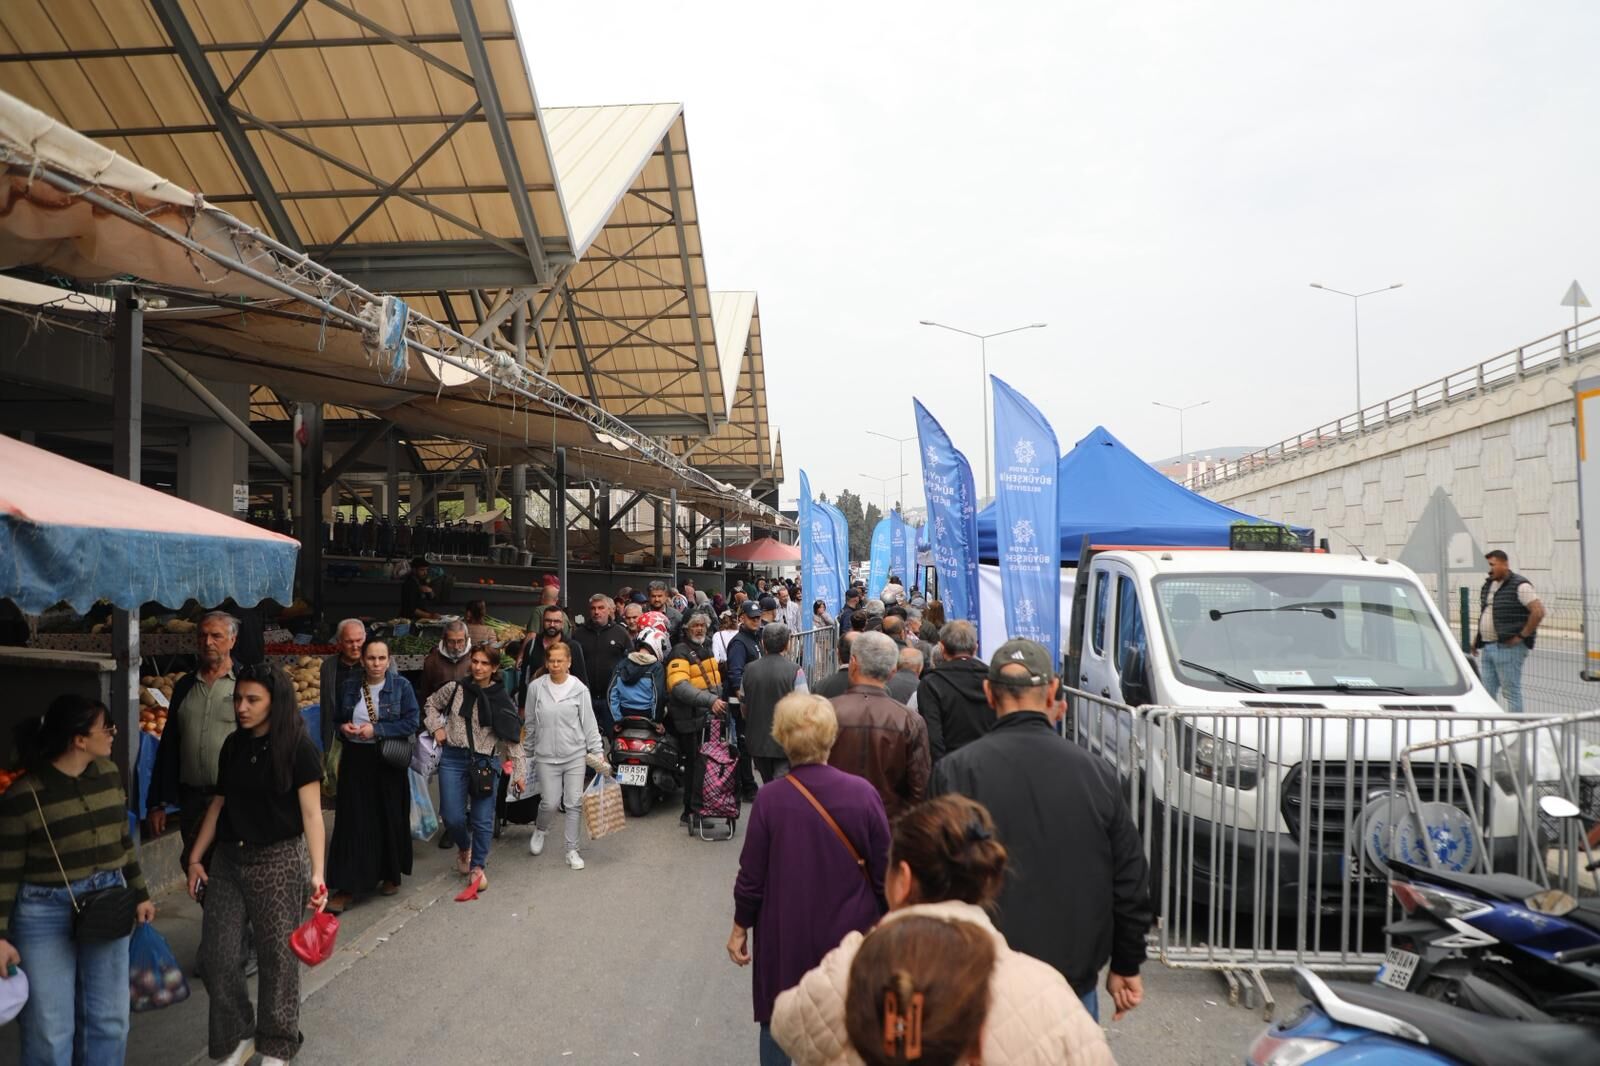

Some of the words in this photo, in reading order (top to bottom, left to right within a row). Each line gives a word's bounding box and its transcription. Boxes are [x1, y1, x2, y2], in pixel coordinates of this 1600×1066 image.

[619, 765, 630, 773] 09
[630, 766, 646, 774] ASM
[630, 774, 645, 782] 378
